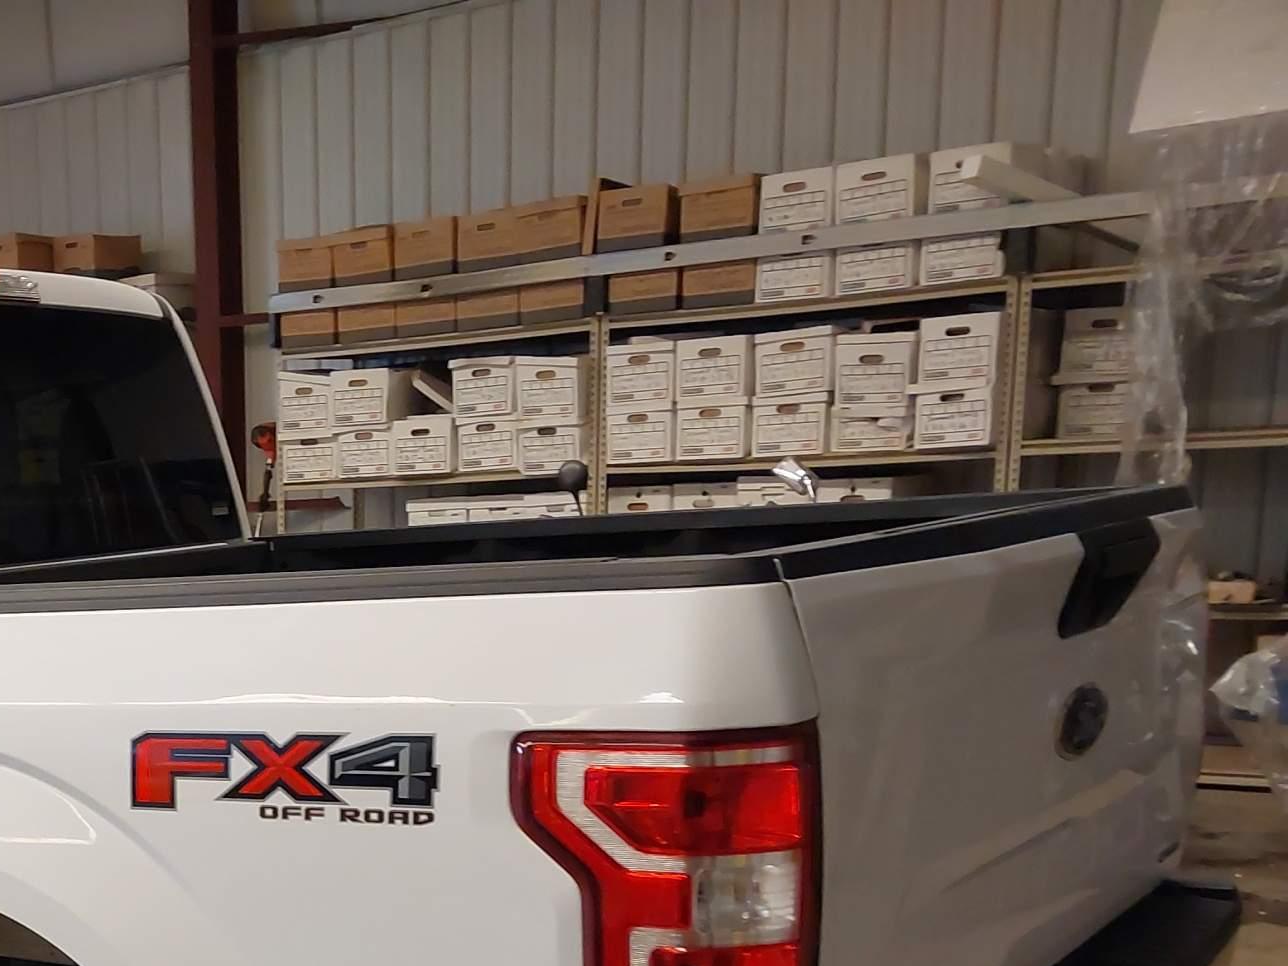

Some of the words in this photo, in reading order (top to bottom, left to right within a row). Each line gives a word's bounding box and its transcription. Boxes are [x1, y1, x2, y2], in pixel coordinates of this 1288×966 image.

[130, 730, 441, 810] FX4
[259, 804, 326, 821] OFF
[339, 806, 436, 827] ROAD
